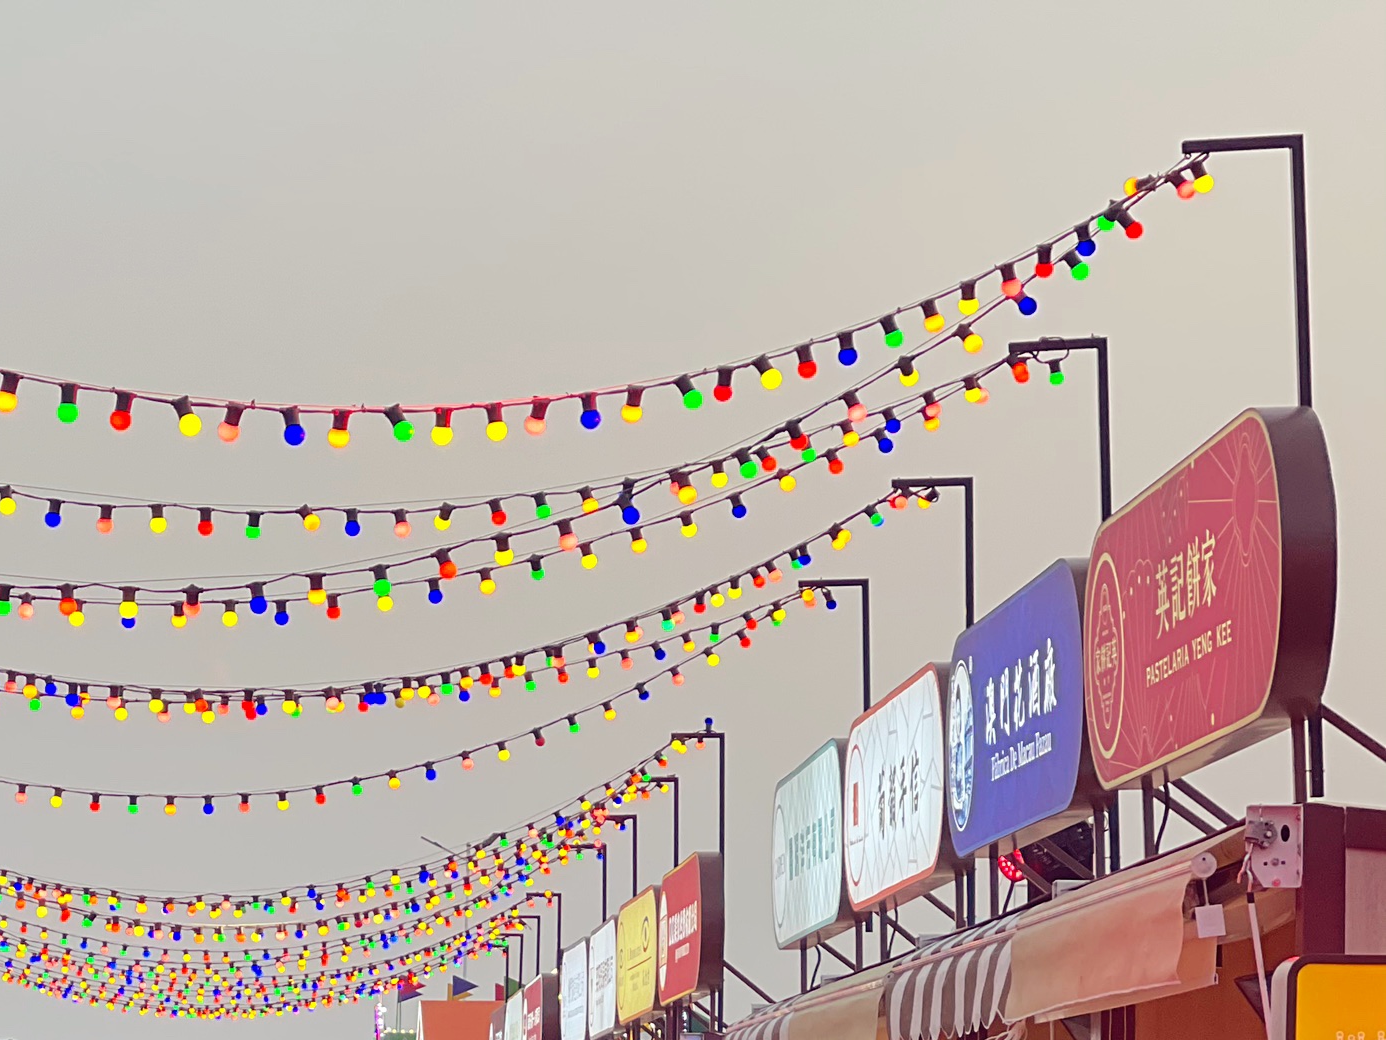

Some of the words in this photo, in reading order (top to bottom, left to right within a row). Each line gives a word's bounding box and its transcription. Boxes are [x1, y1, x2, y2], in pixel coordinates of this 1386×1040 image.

[1155, 528, 1217, 639] 英記餅家
[1145, 643, 1190, 688] PASTELARIA
[1191, 630, 1213, 661] YENG
[1216, 619, 1232, 648] KEE
